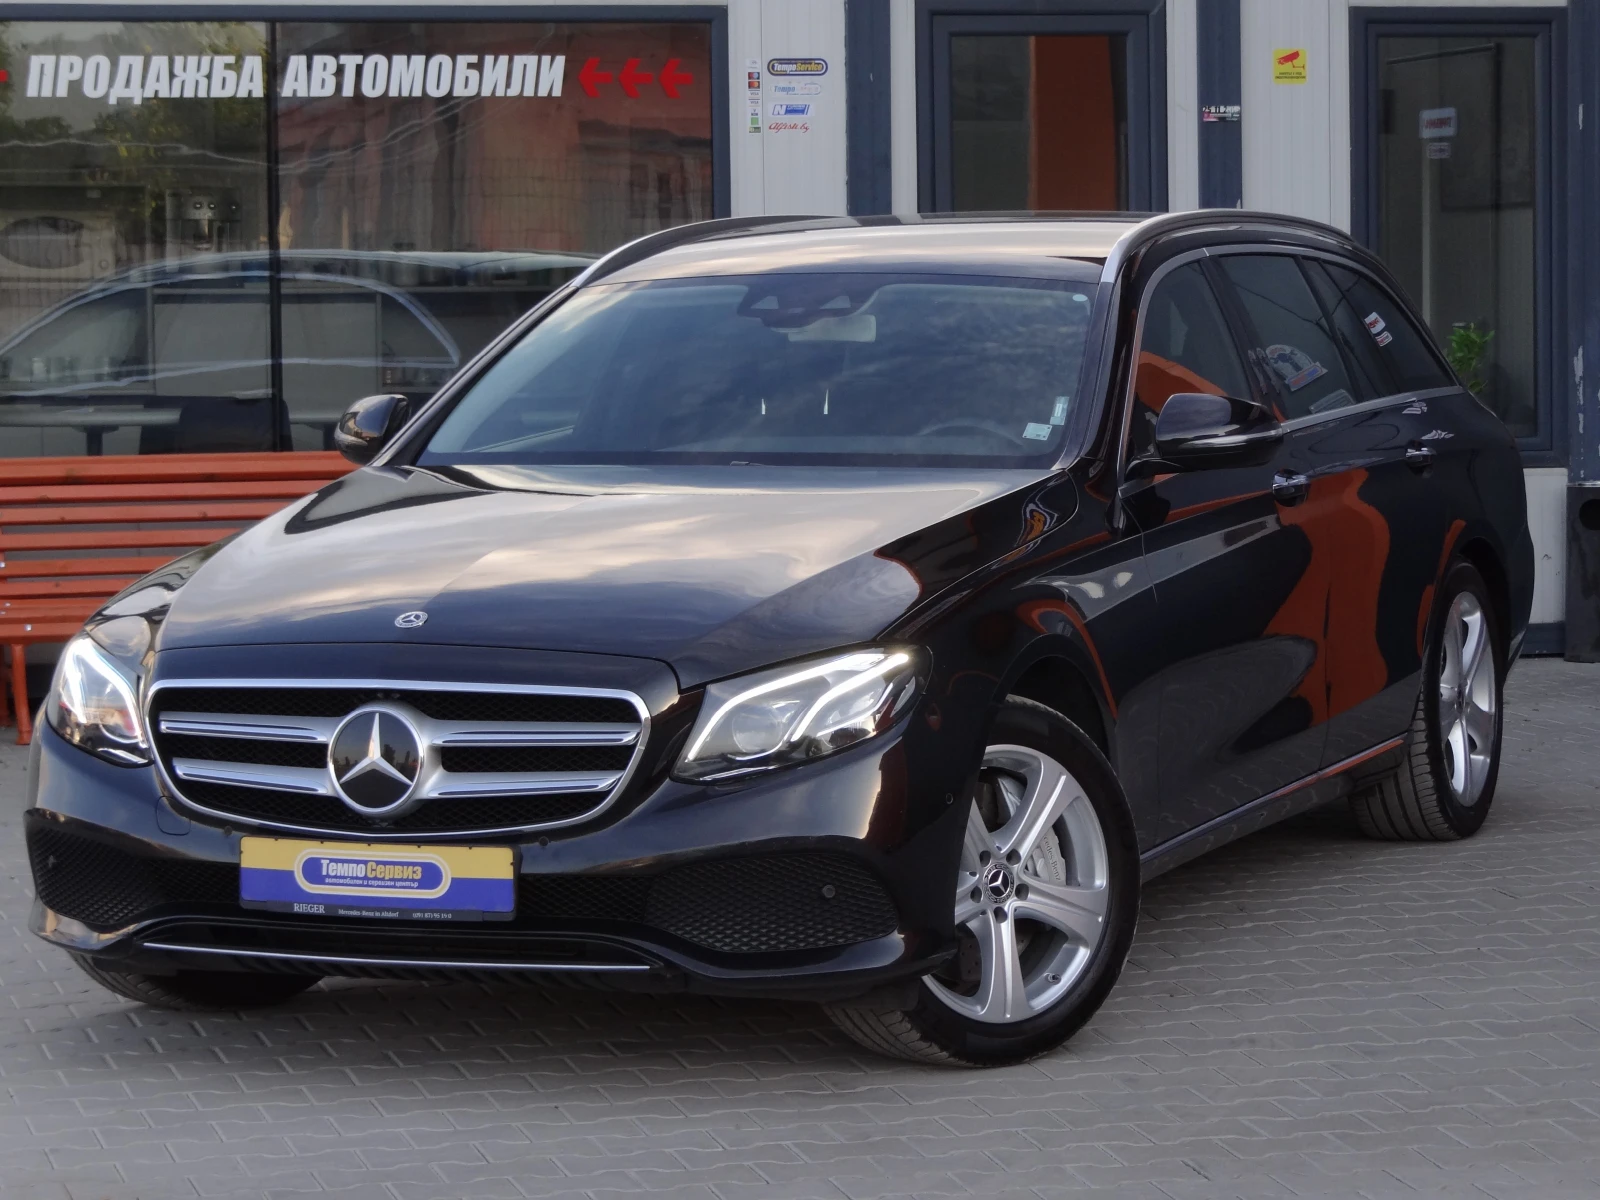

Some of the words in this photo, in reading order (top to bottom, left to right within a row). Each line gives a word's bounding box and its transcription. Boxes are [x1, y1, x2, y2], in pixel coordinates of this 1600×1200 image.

[773, 62, 823, 74] TempoService
[26, 54, 264, 105] ПРОДАЖБА
[281, 54, 566, 99] АВТОМОБИЛИ
[320, 859, 422, 880] ТемпоСервиз
[395, 880, 419, 888] център
[293, 902, 326, 914] RIEGER
[338, 908, 375, 917] Mercedes-Benz
